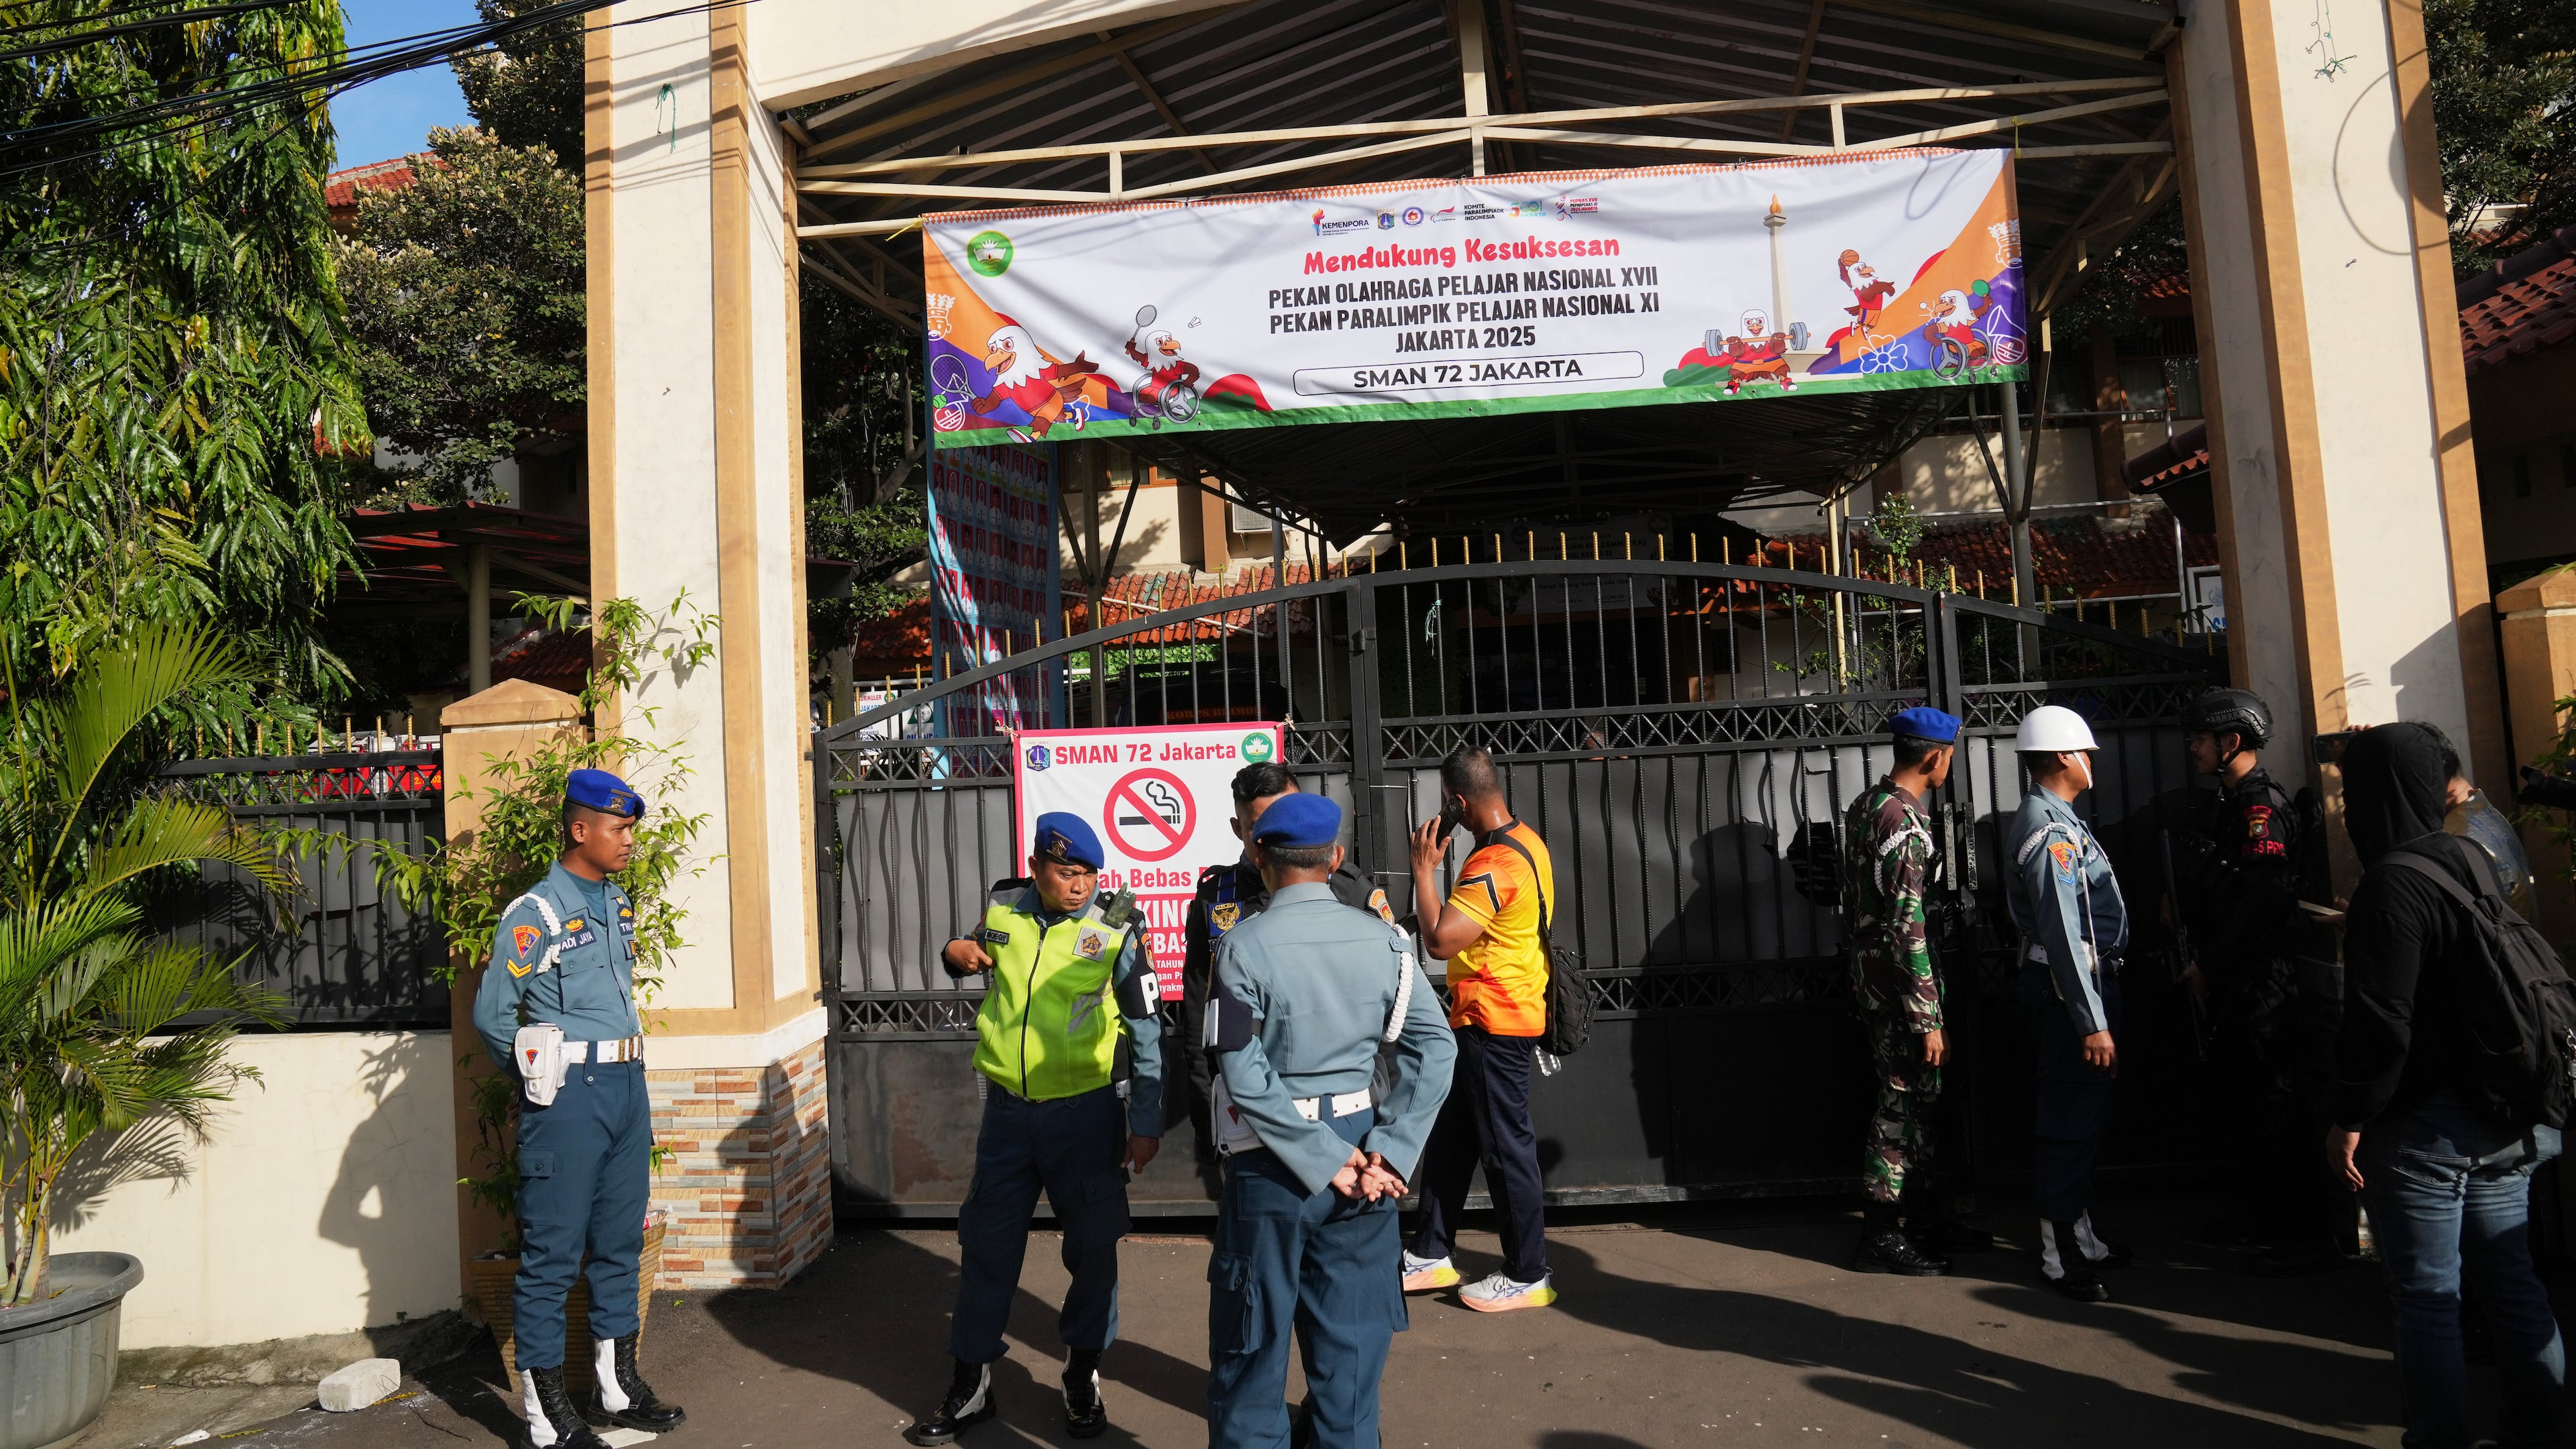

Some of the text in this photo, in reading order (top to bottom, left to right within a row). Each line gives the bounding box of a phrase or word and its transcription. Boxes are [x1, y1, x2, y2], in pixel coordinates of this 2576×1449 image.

[1322, 219, 1369, 229] KEMENPORA
[1303, 236, 1619, 275] Mendukung Kesuksesan
[1269, 266, 1658, 309] PEKAN OLAHRAGA PELAJAR NASIONAL XVII
[1270, 292, 1660, 334] PEKAN PARALIMPIK PELAJAR NASIONAL XI
[1396, 325, 1536, 354] JAKARTA 2025
[1354, 359, 1583, 388] SMAN 72 JAKARTA
[1056, 742, 1236, 765] SMAN 72 Jakarta
[1130, 868, 1191, 888] Bebas
[580, 931, 594, 944] JAYA
[620, 922, 632, 932] TNI
[1156, 960, 1183, 968] TAHUN
[1157, 973, 1172, 981] gan
[1140, 972, 1159, 1014] P
